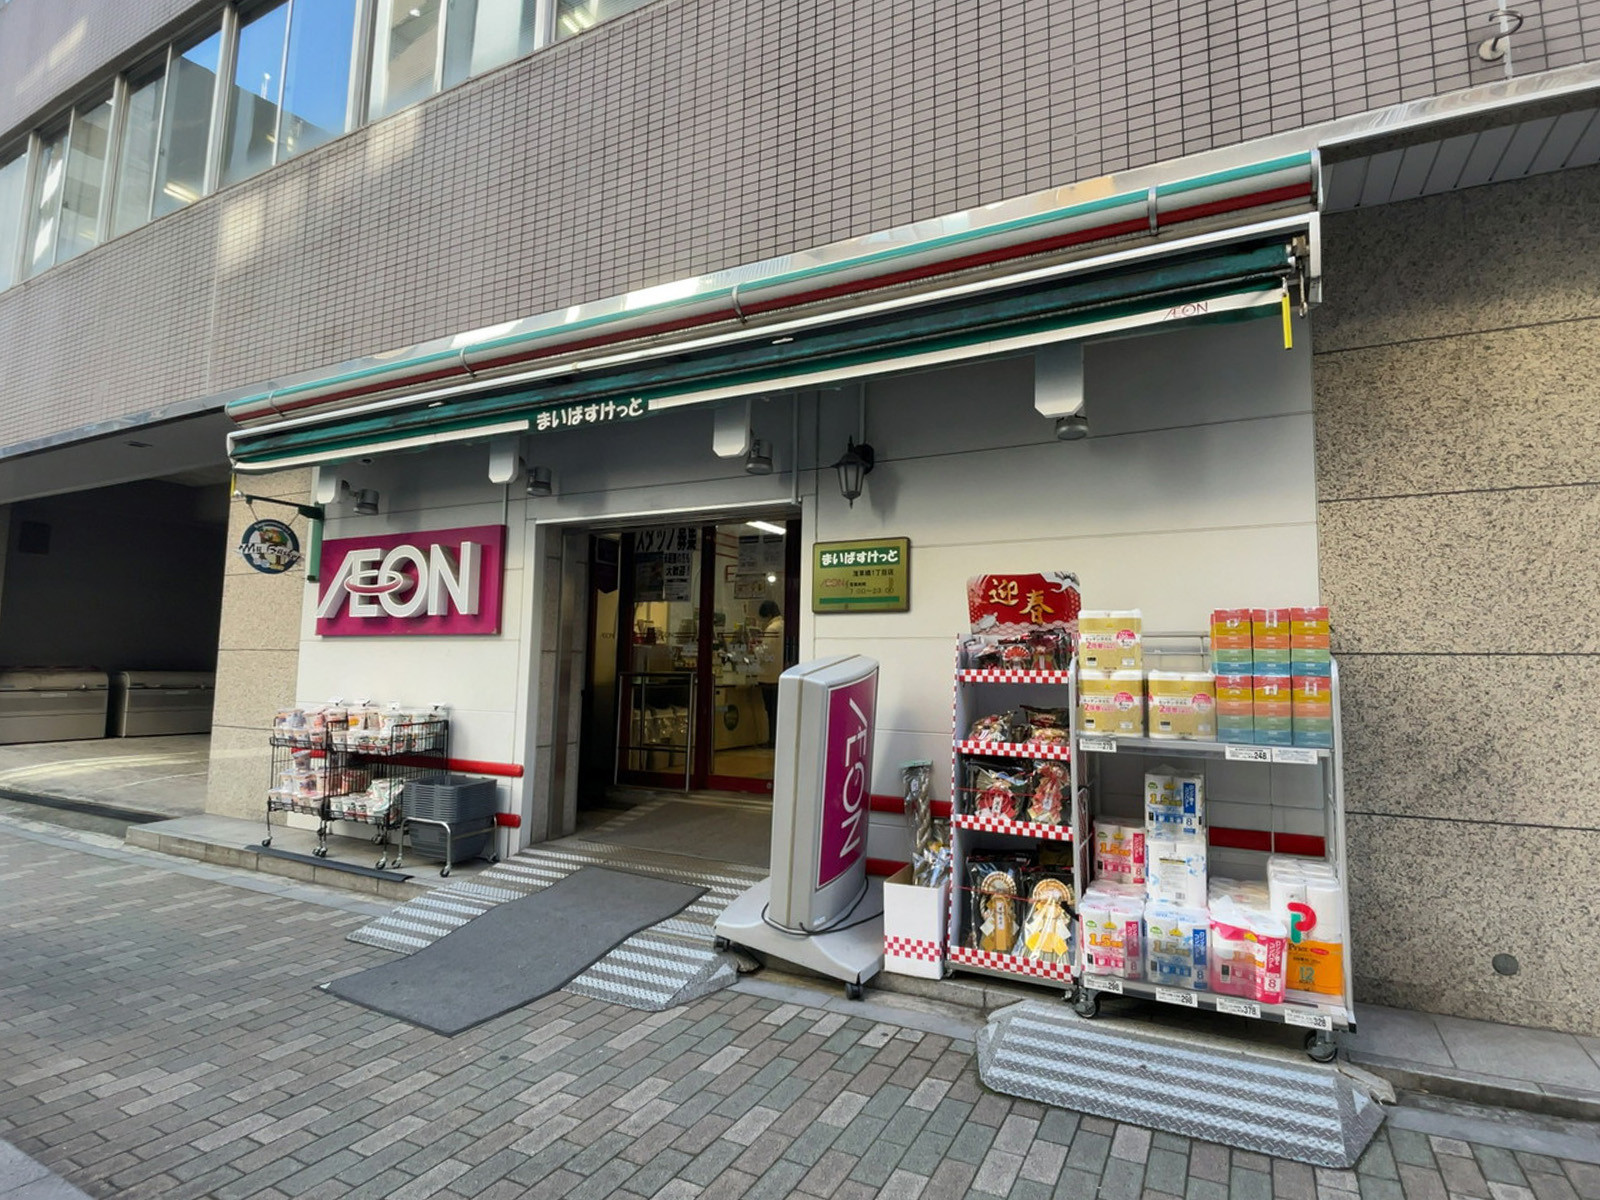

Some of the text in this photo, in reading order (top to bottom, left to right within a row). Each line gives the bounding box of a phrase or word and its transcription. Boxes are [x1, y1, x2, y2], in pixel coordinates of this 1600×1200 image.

[536, 397, 644, 431] まいばすけっと
[821, 549, 899, 567] まいばすけっと
[988, 578, 1055, 627] 迎春
[1254, 751, 1268, 760] 248
[1268, 979, 1276, 989] 8
